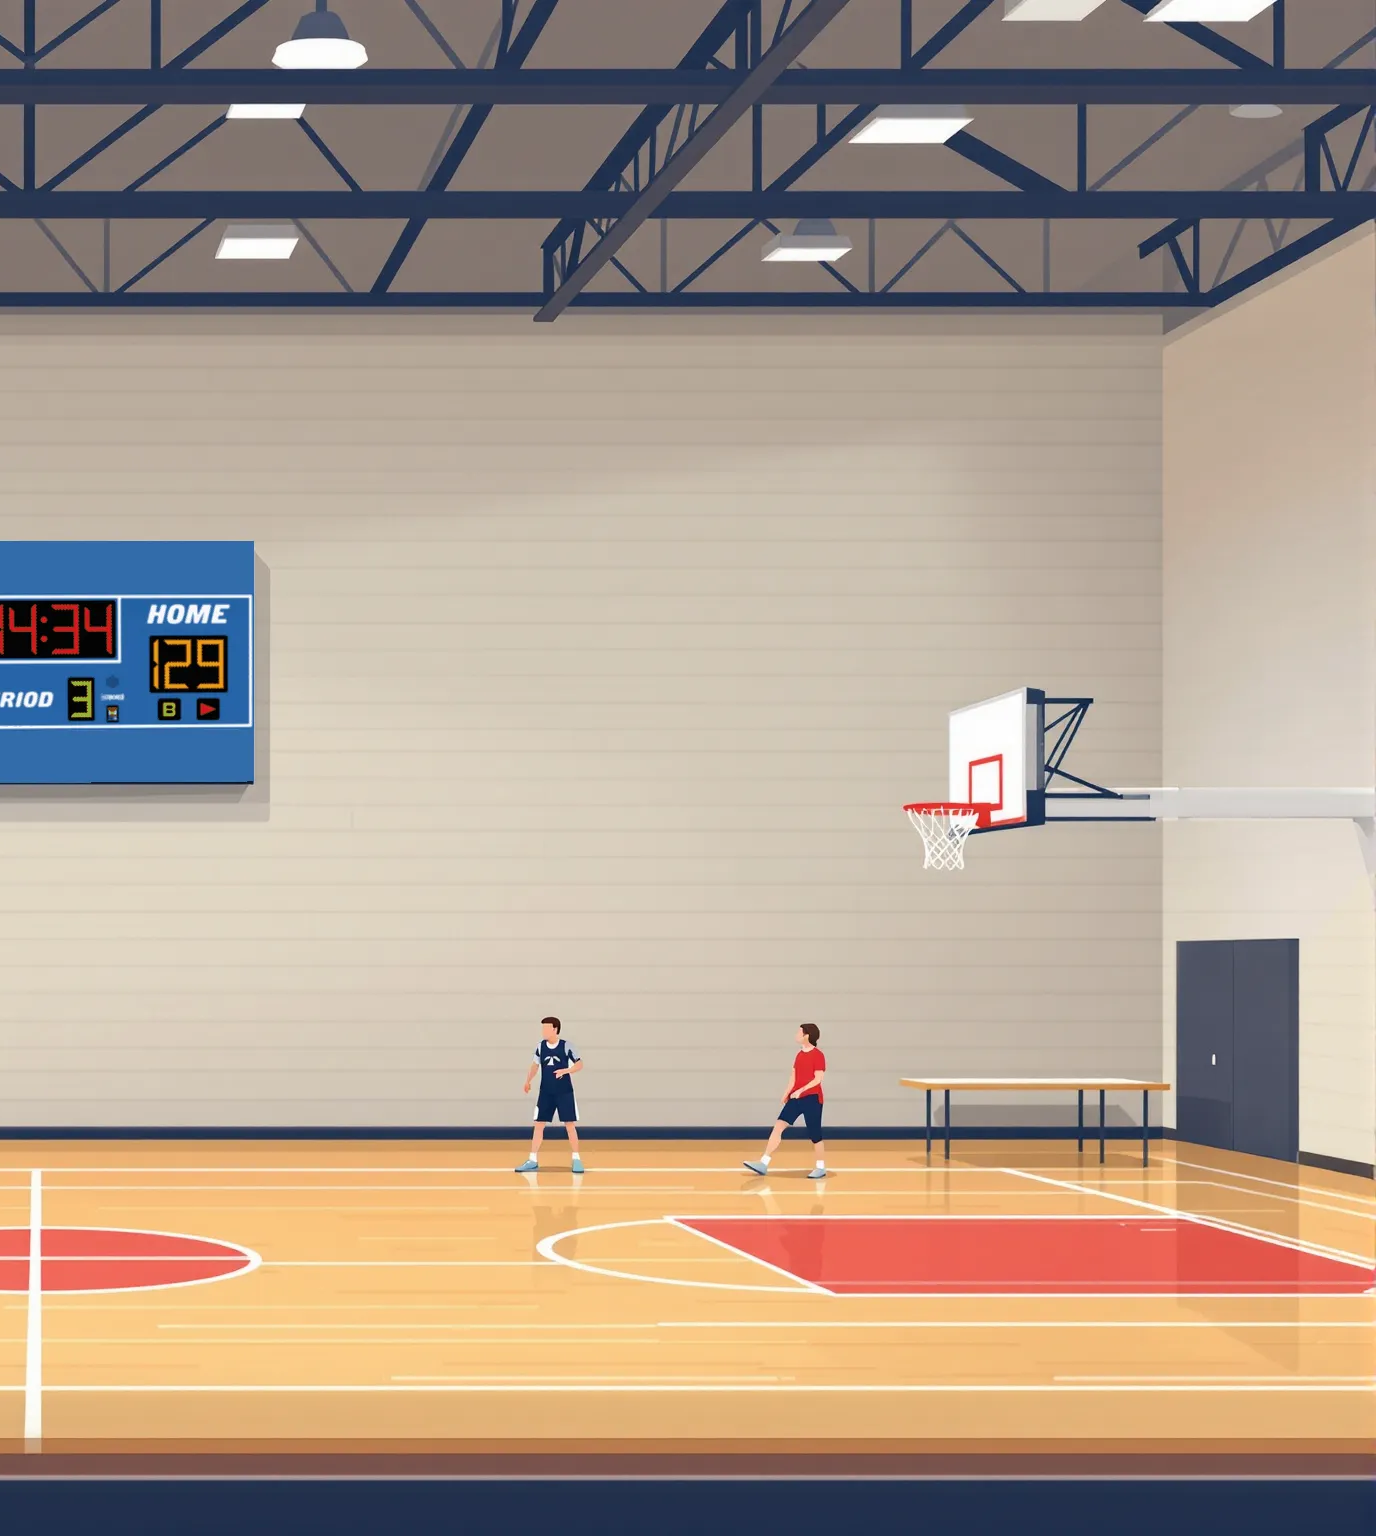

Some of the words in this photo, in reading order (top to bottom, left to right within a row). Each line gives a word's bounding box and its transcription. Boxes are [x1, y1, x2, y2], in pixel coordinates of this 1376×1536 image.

[147, 604, 230, 625] HOME
[152, 639, 225, 690] 129
[70, 680, 93, 718] 3
[162, 702, 177, 718] B
